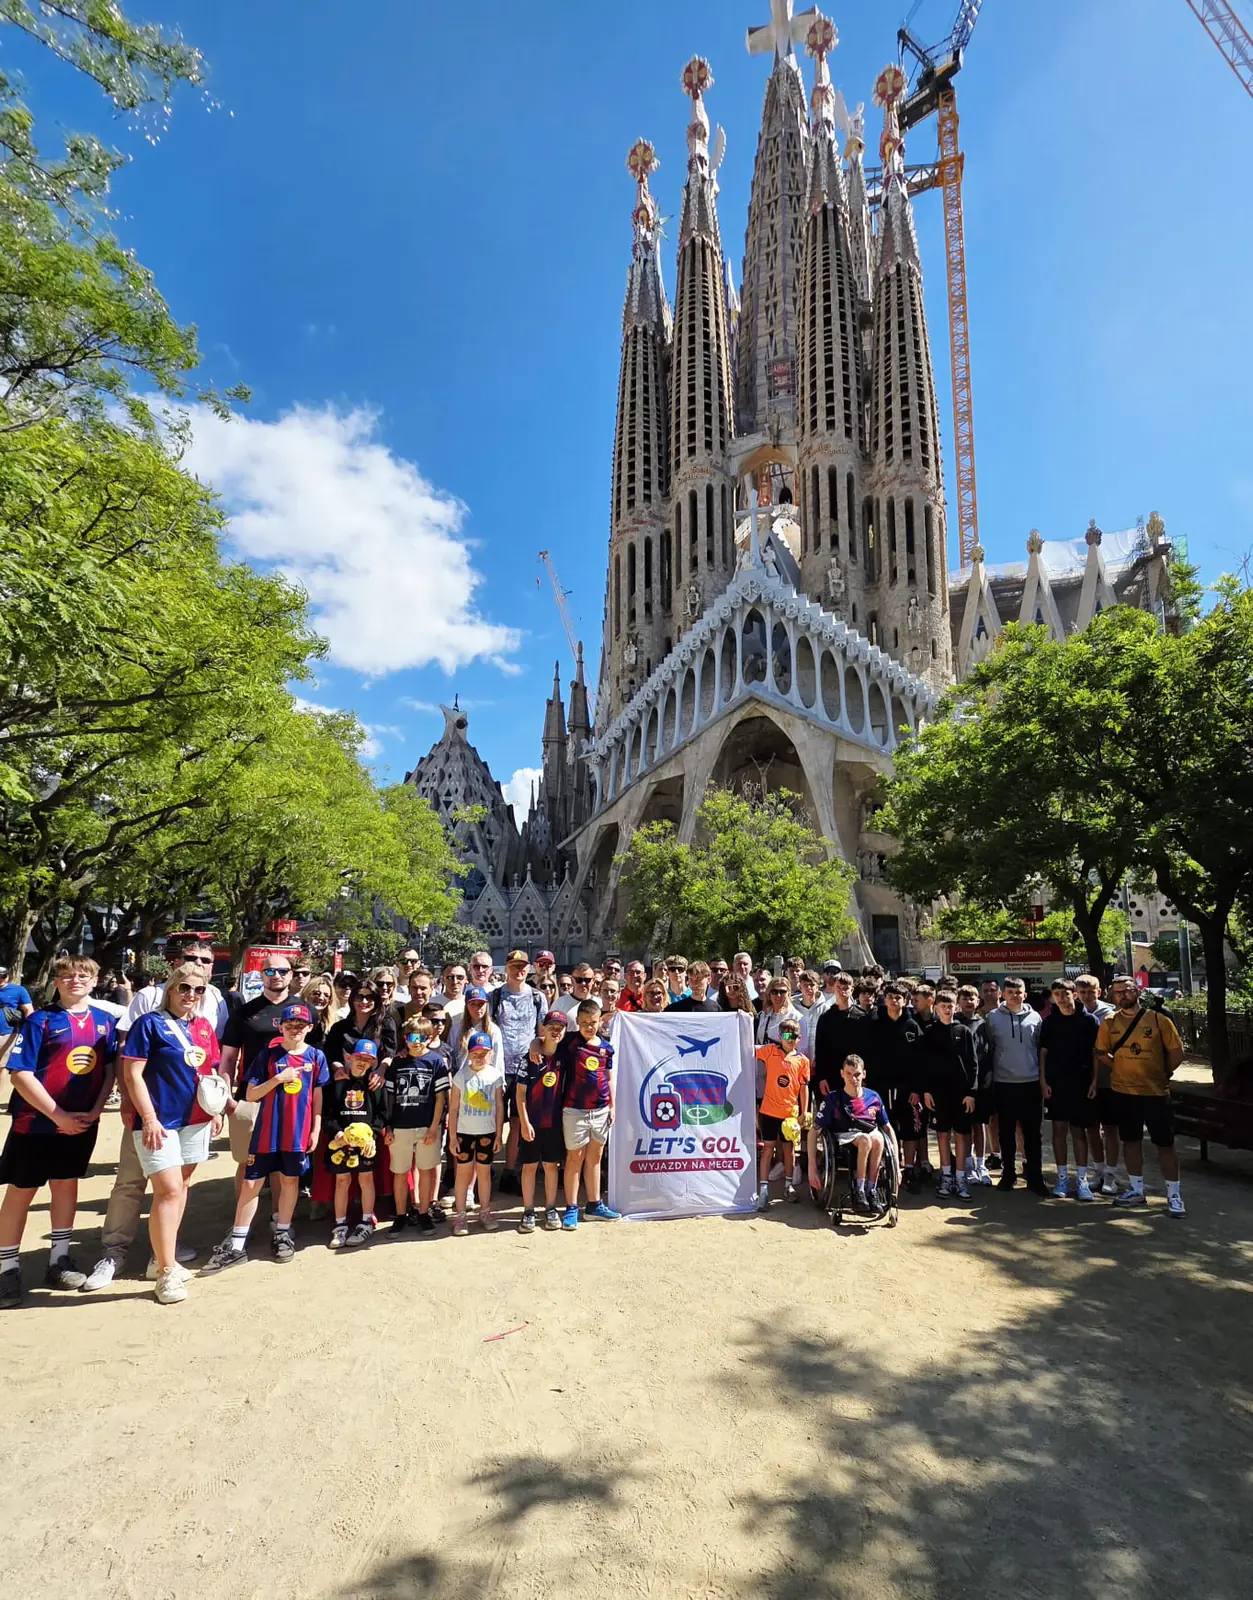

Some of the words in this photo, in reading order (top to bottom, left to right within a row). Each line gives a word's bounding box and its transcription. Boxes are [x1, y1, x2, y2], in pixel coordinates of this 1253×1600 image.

[983, 950, 1007, 958] Tourist
[1009, 949, 1052, 957] Information
[702, 1136, 741, 1154] GOL
[638, 1161, 688, 1171] WYJAZDY
[691, 1161, 705, 1170] NA
[708, 1160, 739, 1169] MECZE
